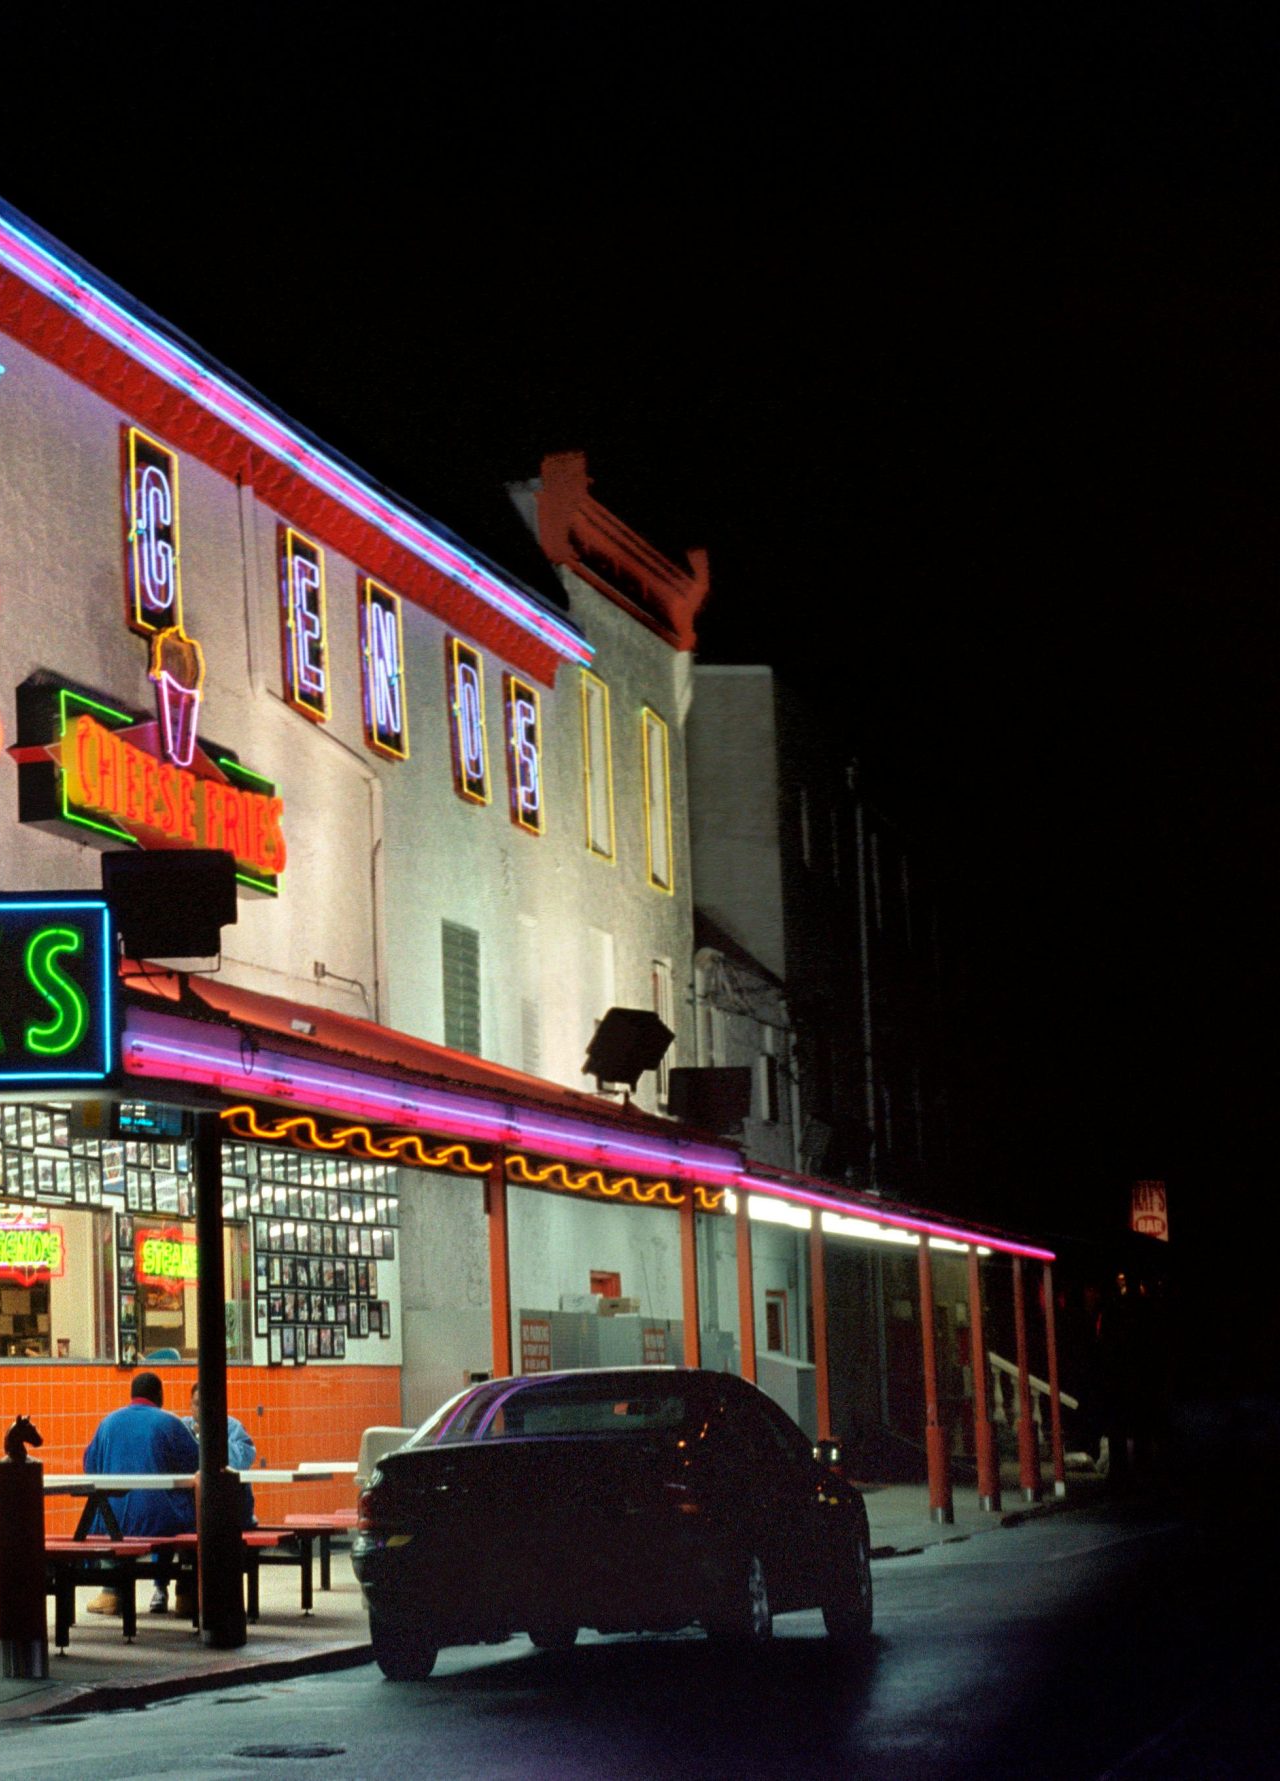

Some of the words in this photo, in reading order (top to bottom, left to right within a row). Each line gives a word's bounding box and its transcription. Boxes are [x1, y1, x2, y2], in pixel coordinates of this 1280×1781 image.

[76, 713, 198, 844] CHEESE
[204, 778, 287, 875] FRIES
[1138, 1219, 1163, 1234] BAR
